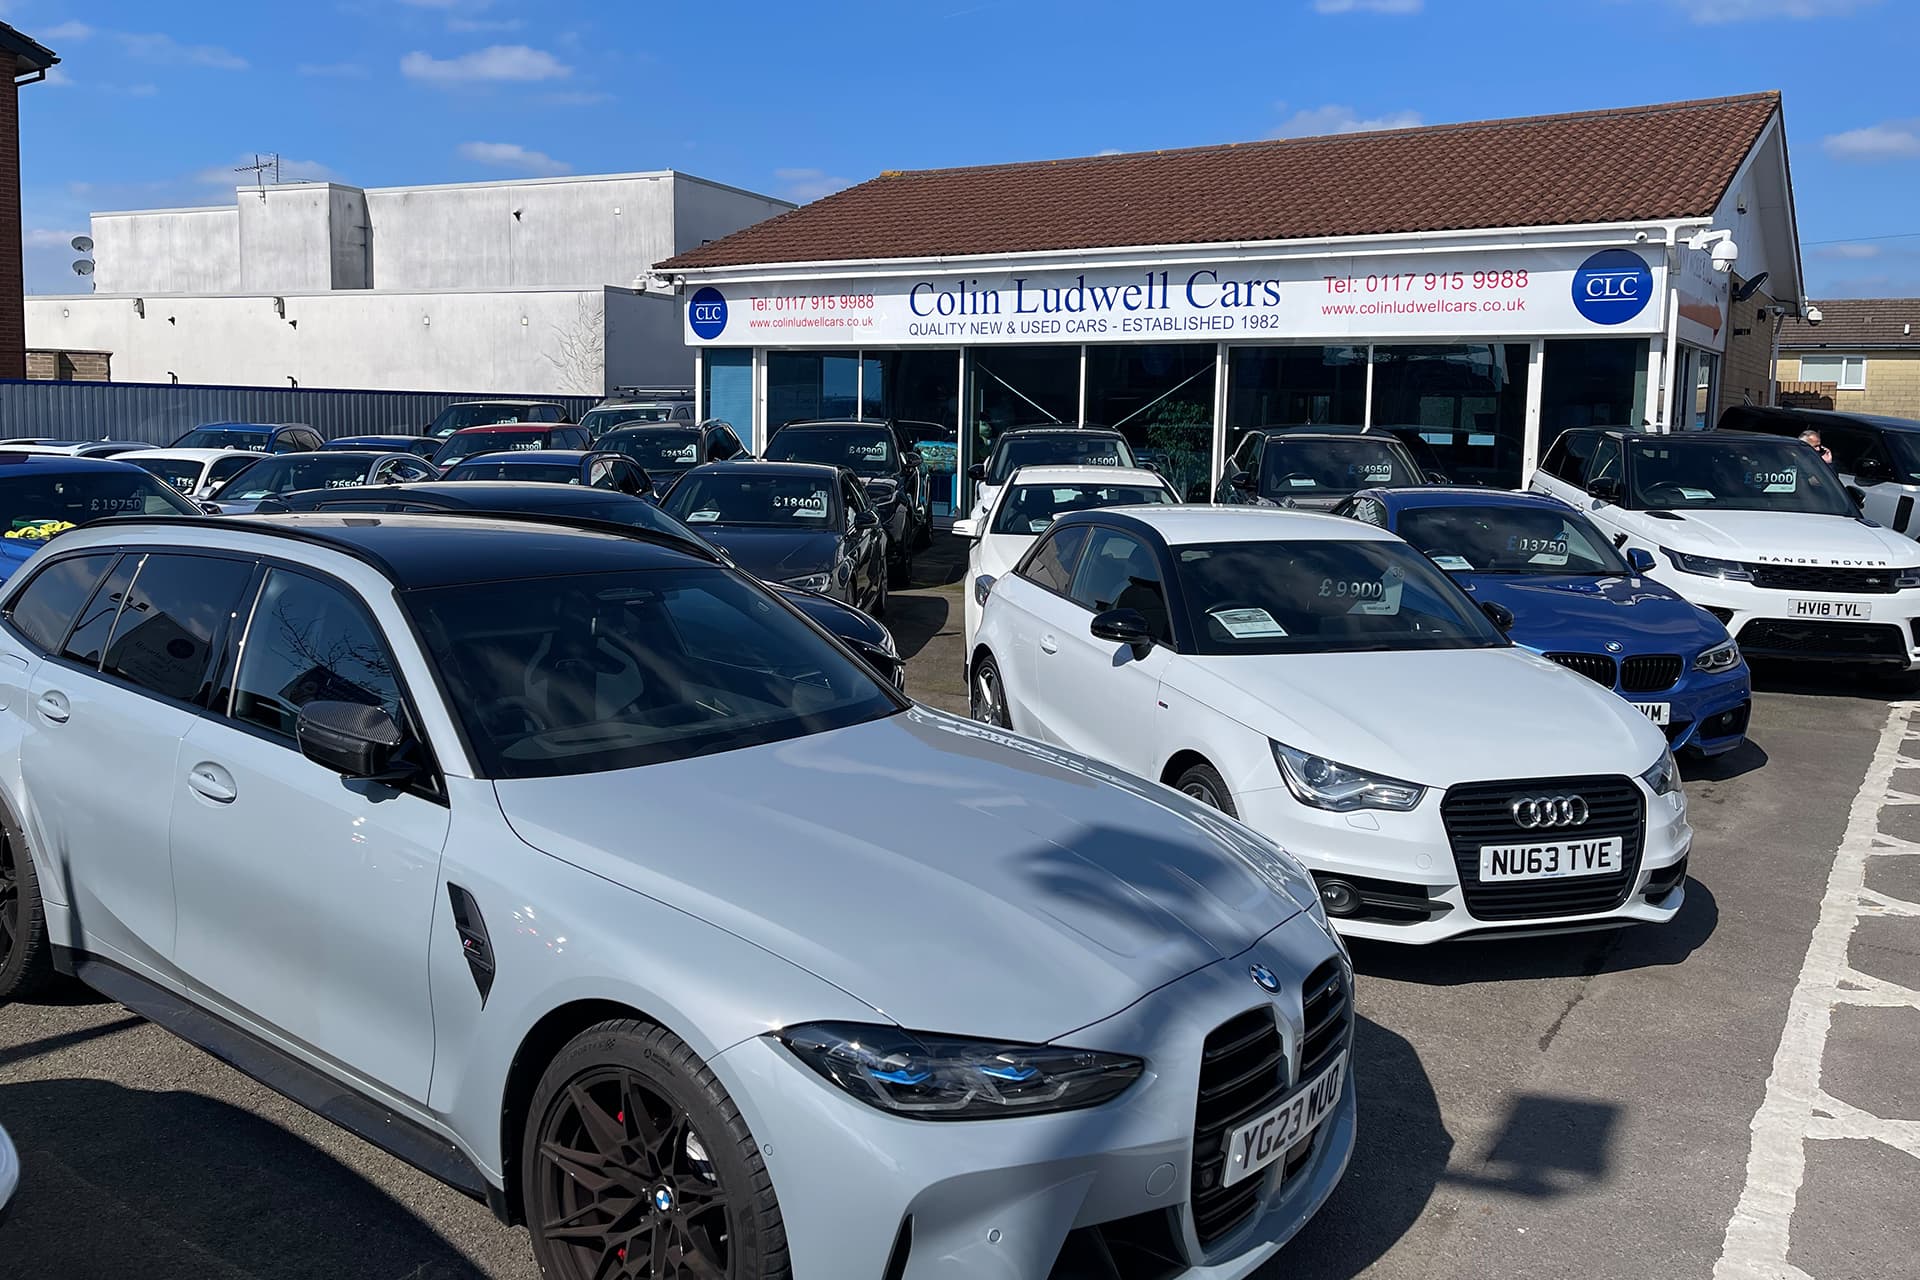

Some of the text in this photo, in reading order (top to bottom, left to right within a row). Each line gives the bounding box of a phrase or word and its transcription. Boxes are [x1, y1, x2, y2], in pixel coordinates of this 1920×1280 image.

[1323, 269, 1529, 293] Tel: 0117 915 9988
[1586, 277, 1638, 297] CLC
[910, 270, 1281, 317] Colin Ludwell Cars
[750, 294, 874, 311] Tel: 0117 915 9988
[1321, 298, 1526, 315] www.colinludwellcars.co.uk
[695, 306, 721, 321] CLC
[749, 316, 873, 328] www.colinludwellcars.co.uk
[909, 321, 967, 336] QUALITY
[971, 321, 1003, 335] NEW
[1006, 320, 1017, 335] &
[1020, 320, 1061, 334] USED
[1065, 319, 1107, 333] CARS
[1122, 315, 1234, 332] ESTABLISHED
[1241, 314, 1280, 329] 1982
[1758, 556, 1818, 564] RANGE
[1797, 601, 1862, 617] HV18 TVL
[1633, 704, 1662, 721] VM
[1491, 842, 1612, 876] NU63 TVE
[1242, 1097, 1304, 1170] YG23
